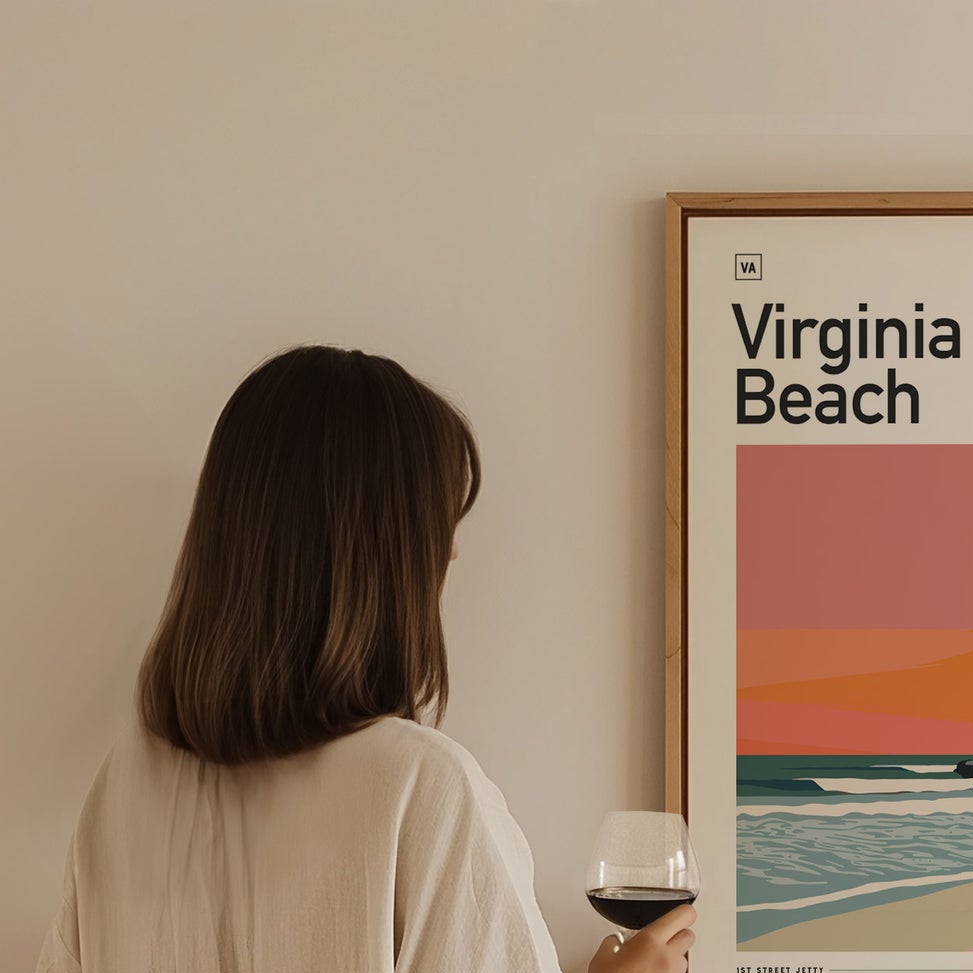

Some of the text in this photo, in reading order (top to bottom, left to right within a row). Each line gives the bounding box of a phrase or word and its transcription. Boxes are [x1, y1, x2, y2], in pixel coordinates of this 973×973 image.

[740, 262, 756, 274] VA
[732, 303, 961, 375] Virginia
[736, 368, 920, 424] Beach
